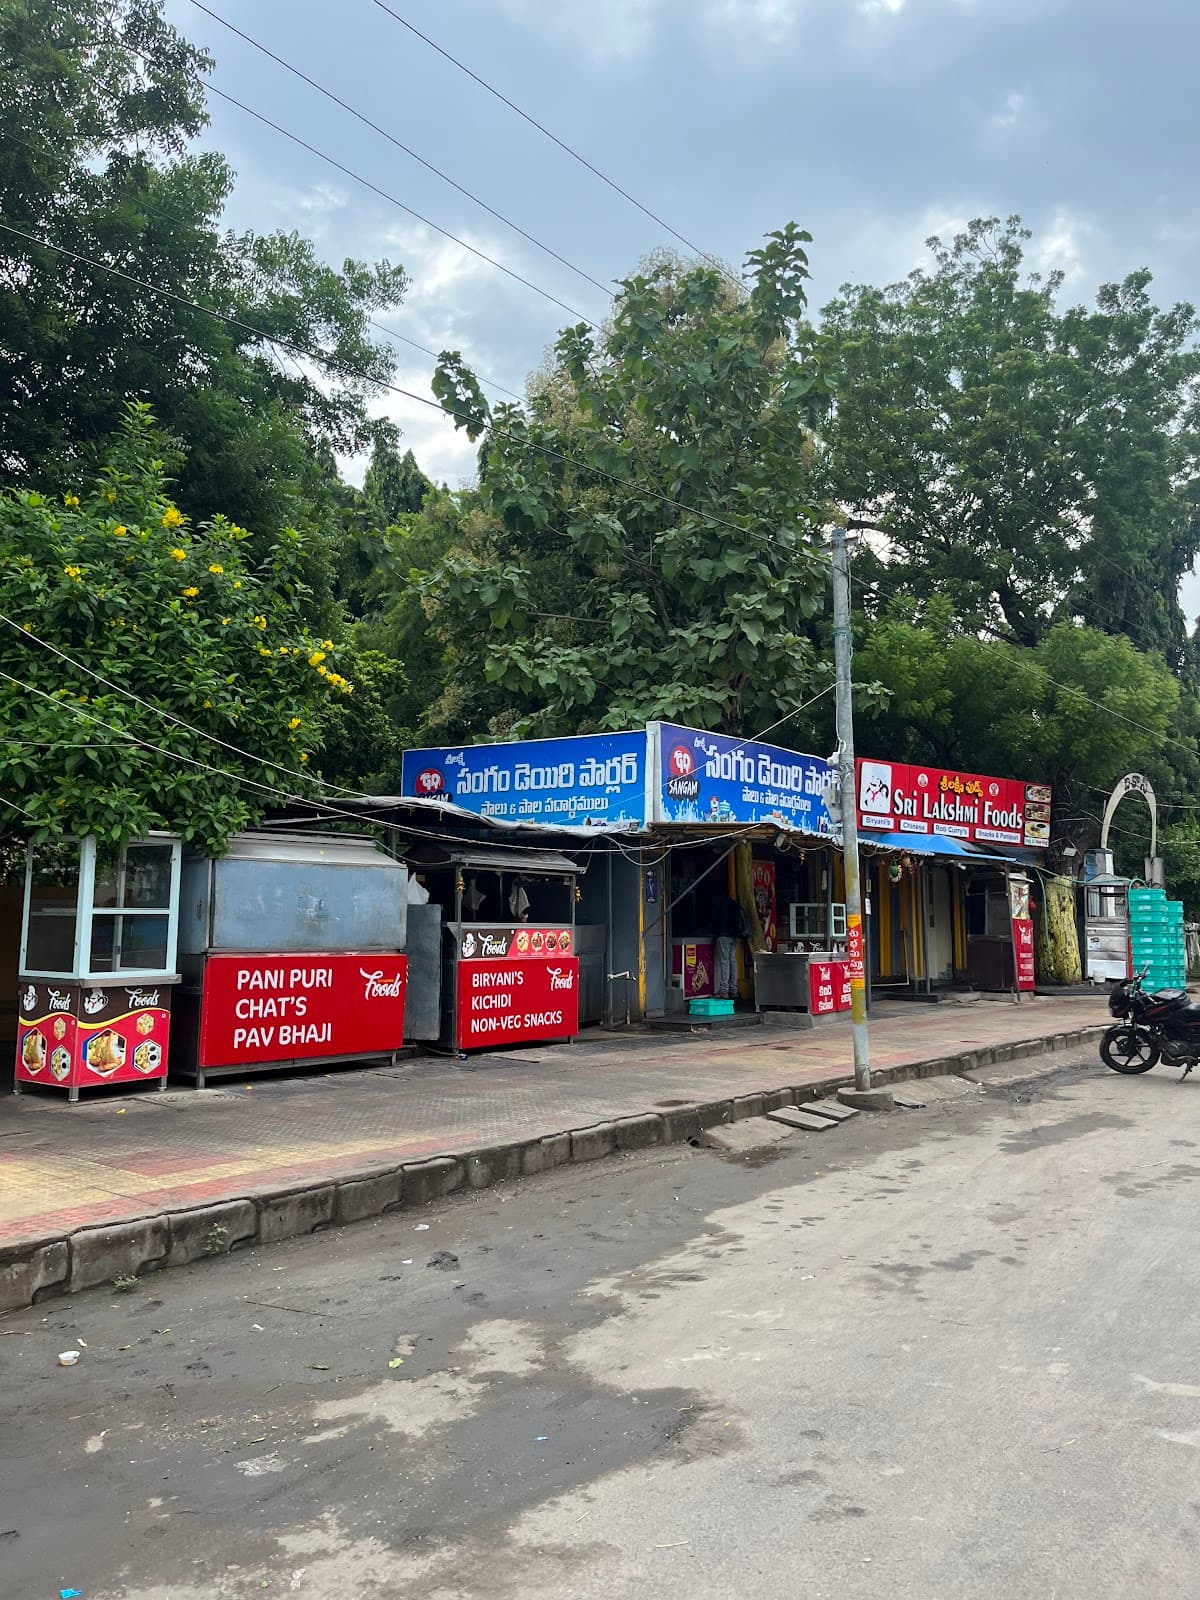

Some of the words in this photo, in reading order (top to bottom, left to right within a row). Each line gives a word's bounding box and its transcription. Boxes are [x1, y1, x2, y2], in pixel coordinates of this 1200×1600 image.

[456, 765, 510, 795] సంగం
[514, 763, 575, 791] డెయిరి
[579, 752, 638, 794] పార్లర్
[706, 744, 755, 784] సంగం
[668, 779, 699, 796] SANGAM
[481, 800, 508, 816] పాలు
[518, 799, 542, 814] పాల
[984, 801, 1023, 829] Foods
[865, 817, 891, 826] Biryani's
[477, 932, 508, 957] Foods
[236, 969, 285, 991] PANI
[289, 968, 334, 989] PURI
[359, 967, 402, 1001] Foods
[472, 971, 524, 988] BIRYANI'S
[546, 965, 574, 992] Foods
[47, 987, 72, 1011] Foods
[124, 987, 160, 1009] Foods
[234, 997, 308, 1020] CHAT'S
[471, 994, 512, 1011] KICHIDI
[471, 1014, 522, 1034] NON-VEG
[524, 1010, 563, 1028] SNACKS
[233, 1025, 275, 1049] PAV
[279, 1022, 333, 1046] BHAJI
